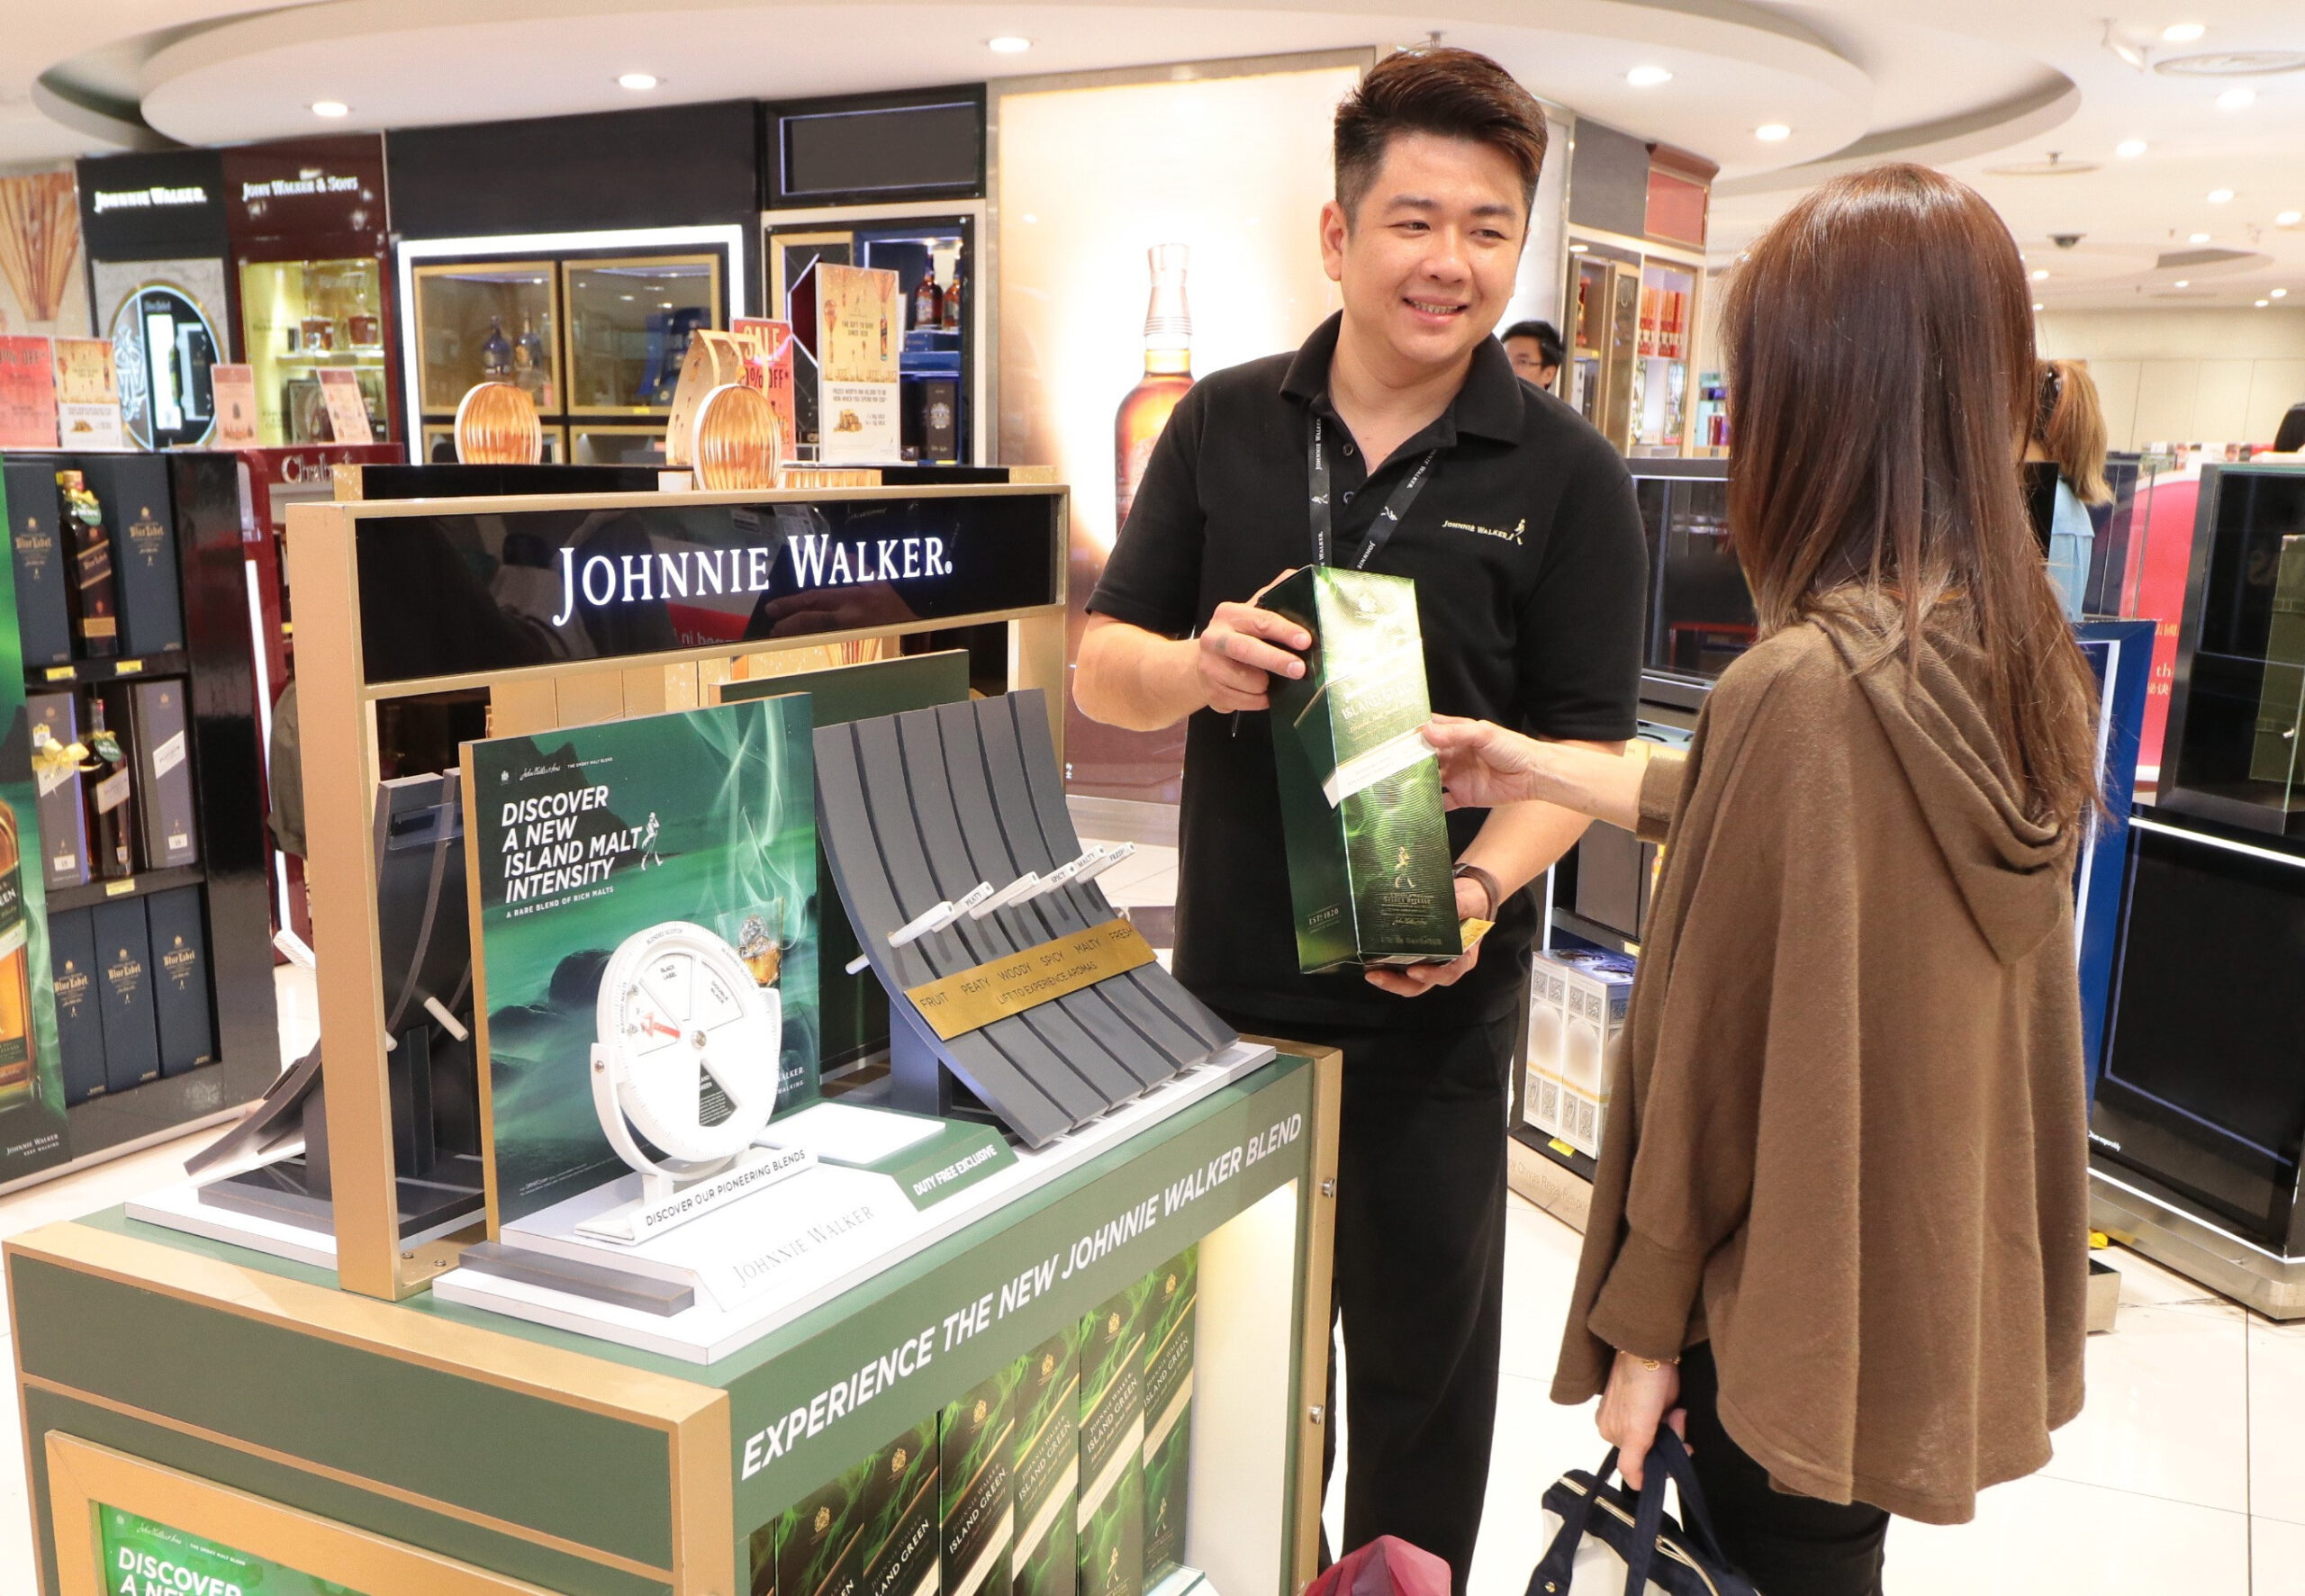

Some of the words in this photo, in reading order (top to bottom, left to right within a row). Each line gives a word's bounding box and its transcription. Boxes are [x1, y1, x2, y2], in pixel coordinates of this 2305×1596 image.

[242, 183, 270, 202] JOHN
[271, 180, 315, 195] WALKER
[327, 176, 358, 191] SONS
[743, 325, 782, 363] SALE
[1442, 519, 1476, 532] JOHNNIE
[1356, 540, 1376, 570] JOHNNIE
[552, 546, 770, 627] JOHNNIE
[502, 785, 610, 827] DISCOVER
[502, 827, 519, 852] A
[525, 816, 578, 848] NEW
[504, 840, 583, 879] ISLAND
[589, 826, 643, 859] MALT
[505, 857, 615, 904] INTENSITY
[965, 892, 982, 907] PEATY
[1051, 871, 1066, 885] SPICY
[506, 911, 511, 919] A
[514, 906, 533, 917] RARE
[536, 900, 559, 912] BLEND
[562, 897, 571, 905] OF
[574, 891, 590, 903] RICH
[592, 886, 614, 897] MALTS
[1324, 908, 1340, 919] 1820
[108, 969, 124, 980] Blue
[123, 963, 141, 976] Label
[163, 955, 178, 967] Blue
[178, 951, 195, 963] Label
[919, 992, 948, 1009] FRUIT
[960, 978, 990, 995] PEATY
[998, 962, 1033, 981] WOODY
[1040, 951, 1065, 967] SPICY
[1074, 938, 1100, 954] MALTY
[1108, 927, 1134, 942] FRESH
[54, 981, 70, 992] Blue
[69, 975, 88, 988] Label
[997, 991, 1015, 1005] LIFT
[1013, 988, 1024, 999] TO
[1024, 973, 1067, 996] EXPERIENCE
[1067, 961, 1098, 979] AROMAS
[646, 1198, 693, 1227] DISCOVER
[695, 1189, 715, 1205] OUR
[717, 1165, 772, 1195] PIONEERING
[773, 1150, 806, 1170] BLENDS
[912, 1175, 936, 1196] DUTY
[935, 1165, 959, 1185] FREE
[954, 1144, 998, 1175] EXCLUSIVE
[732, 1238, 809, 1288] JOHNNIE
[807, 1206, 874, 1244] WALKER
[741, 1326, 937, 1482] EXPERIENCE
[943, 1292, 993, 1353] THE
[998, 1254, 1060, 1321] NEW
[1062, 1193, 1160, 1281] JOHNNIE
[1163, 1146, 1243, 1213] WALKER
[1246, 1113, 1302, 1166] BLEND
[1143, 1370, 1168, 1408] ISLAND
[1168, 1336, 1189, 1370] GREEN
[1087, 1413, 1115, 1454] ISLAND
[1114, 1378, 1138, 1413] GREEN
[1089, 1402, 1113, 1439] JOHNNIE
[1018, 1458, 1046, 1501] ISLAND
[1046, 1421, 1071, 1458] GREEN
[949, 1509, 980, 1555] ISLAND
[980, 1468, 1007, 1509] GREEN
[118, 1546, 242, 1596] DISCOVER
[874, 1562, 900, 1596] LAND
[900, 1519, 930, 1563] GREEN
[120, 1574, 137, 1596] A
